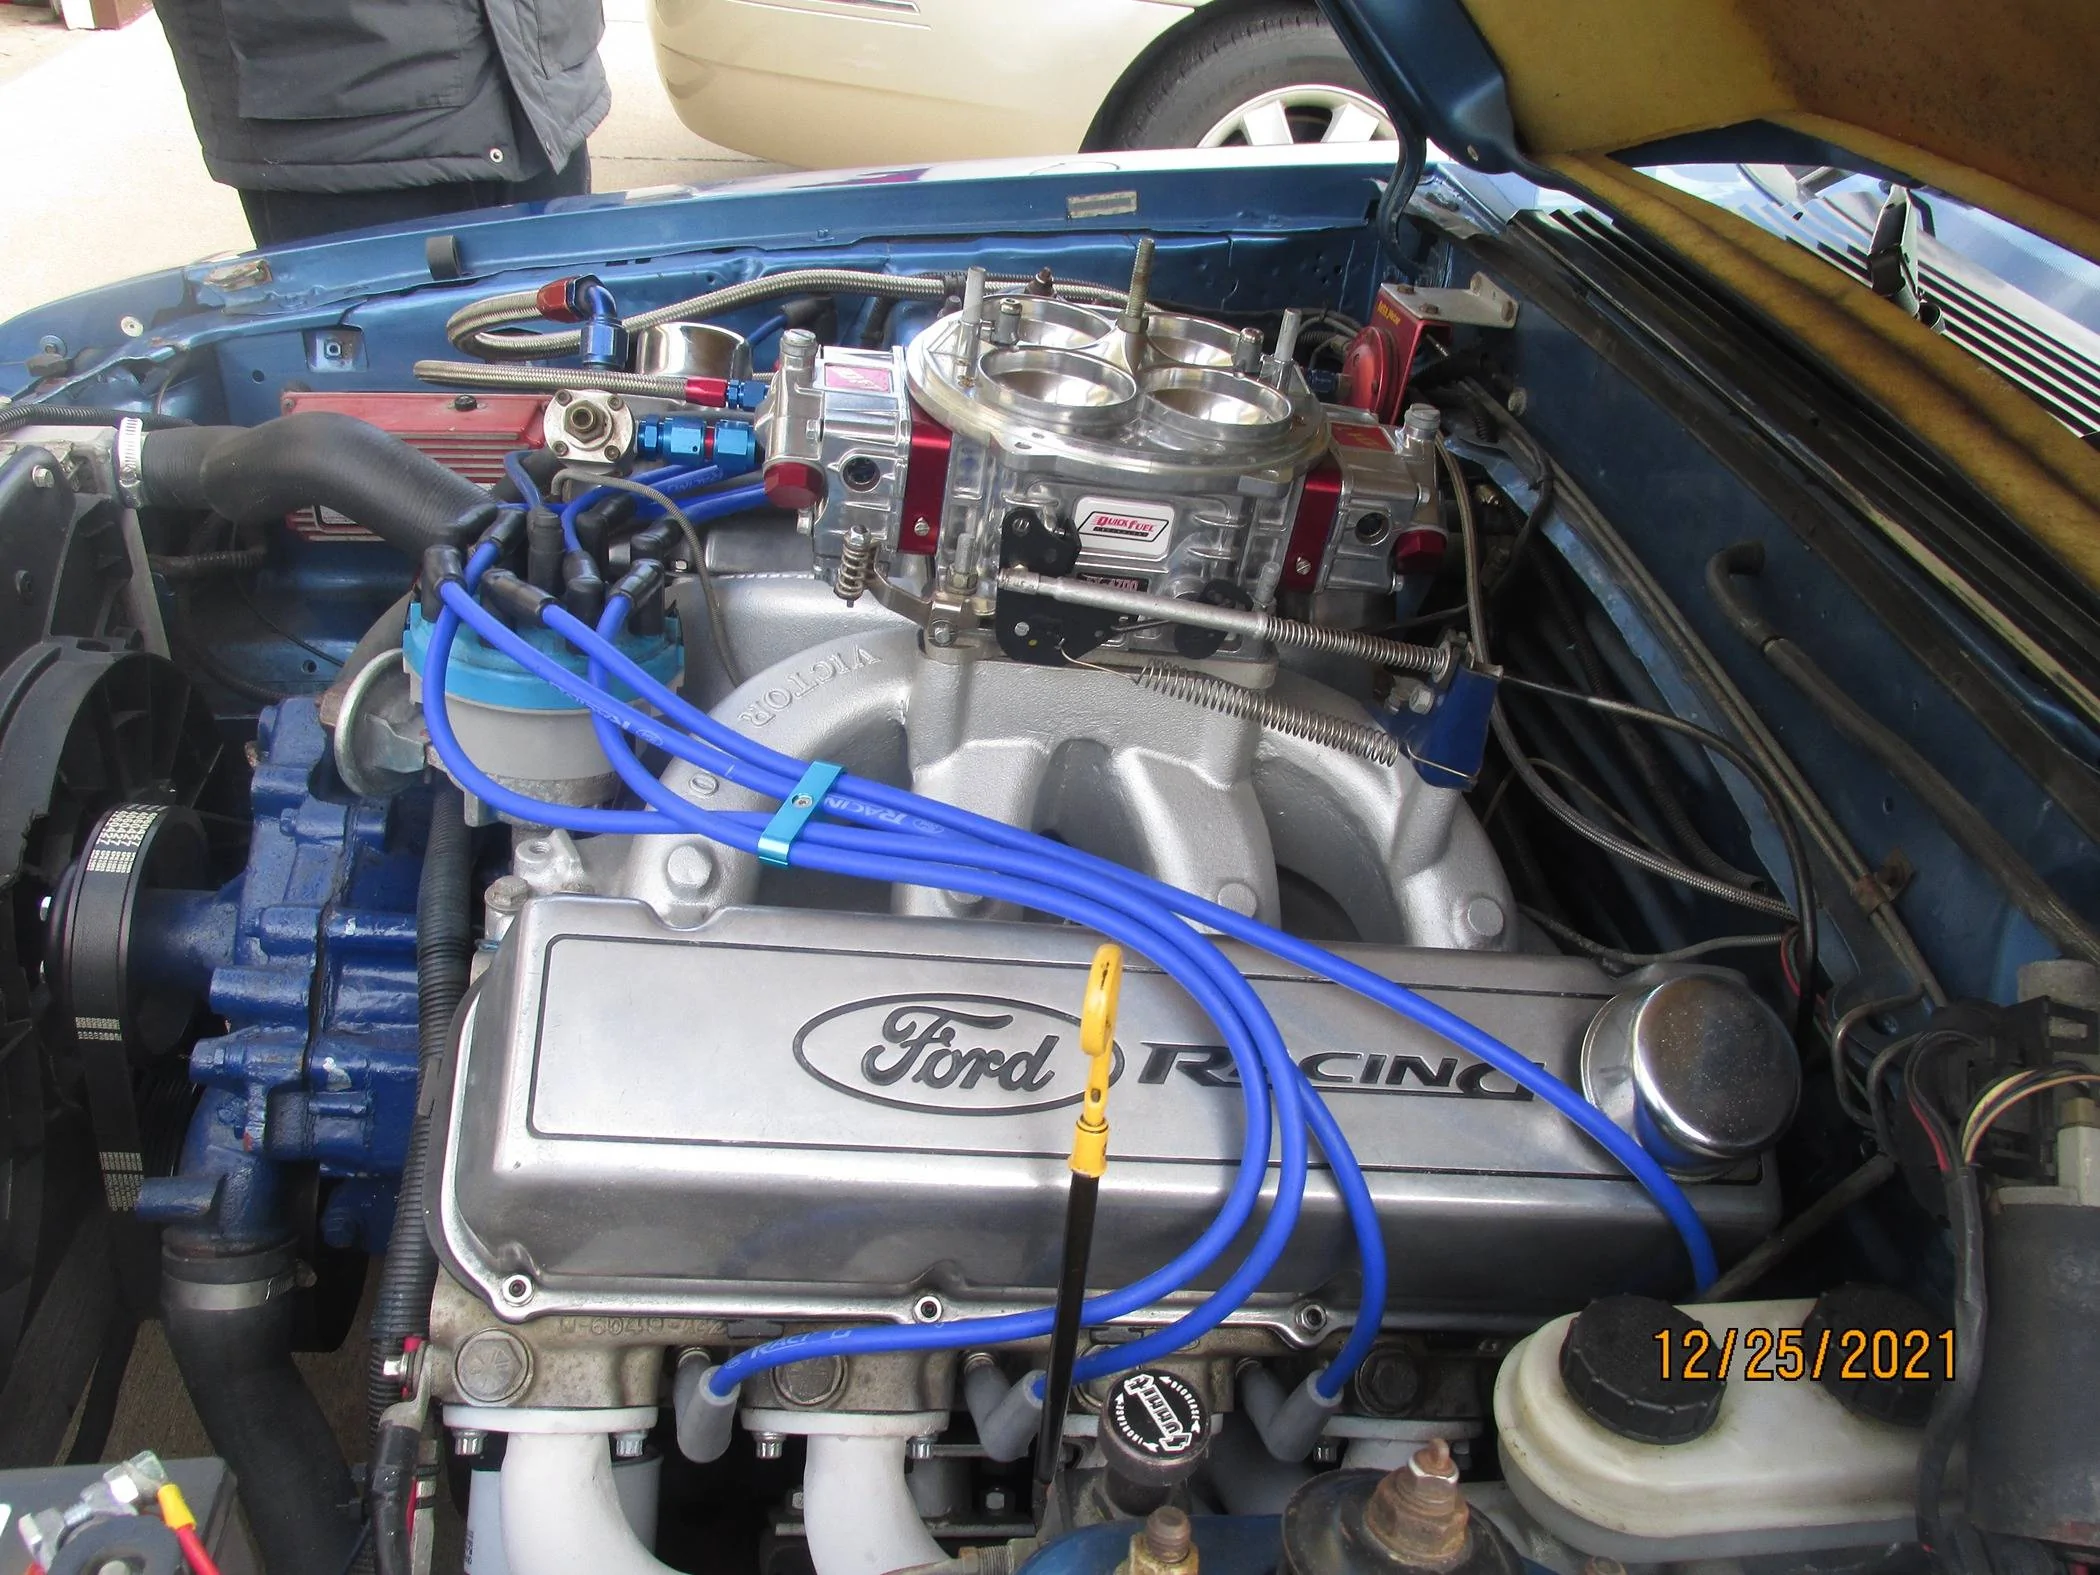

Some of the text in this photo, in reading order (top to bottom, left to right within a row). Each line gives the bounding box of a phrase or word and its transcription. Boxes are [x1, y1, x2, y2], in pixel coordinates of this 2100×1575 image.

[737, 643, 882, 727] VICTOR
[823, 793, 909, 826] RACIN
[861, 1005, 1547, 1101] Ford RCING
